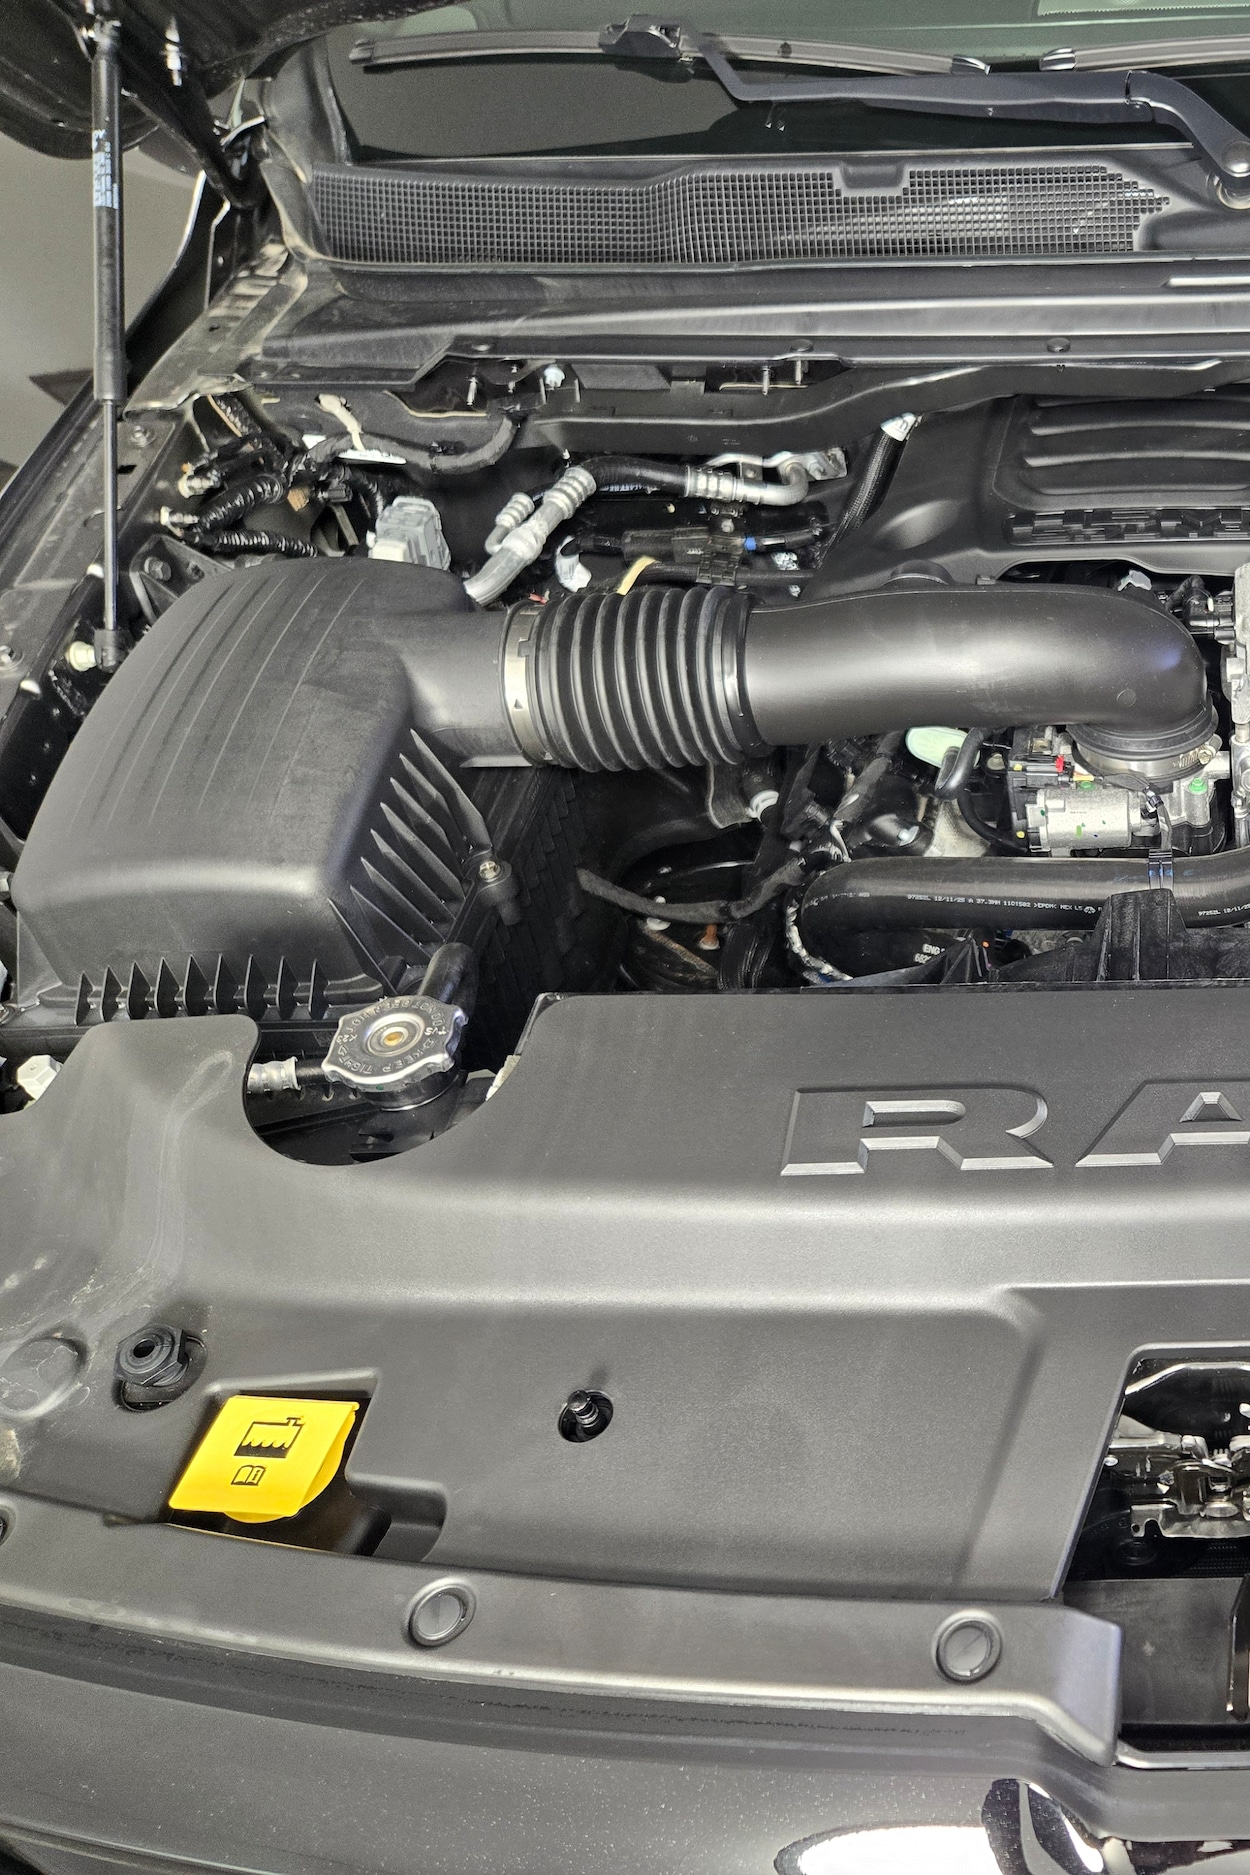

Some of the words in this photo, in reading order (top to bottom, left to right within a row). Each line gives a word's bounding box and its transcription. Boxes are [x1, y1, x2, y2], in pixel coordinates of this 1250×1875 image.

[934, 895, 966, 903] 12/11/25
[922, 943, 946, 956] ENG
[338, 1056, 375, 1075] TIGHT
[382, 1049, 424, 1073] KEEP
